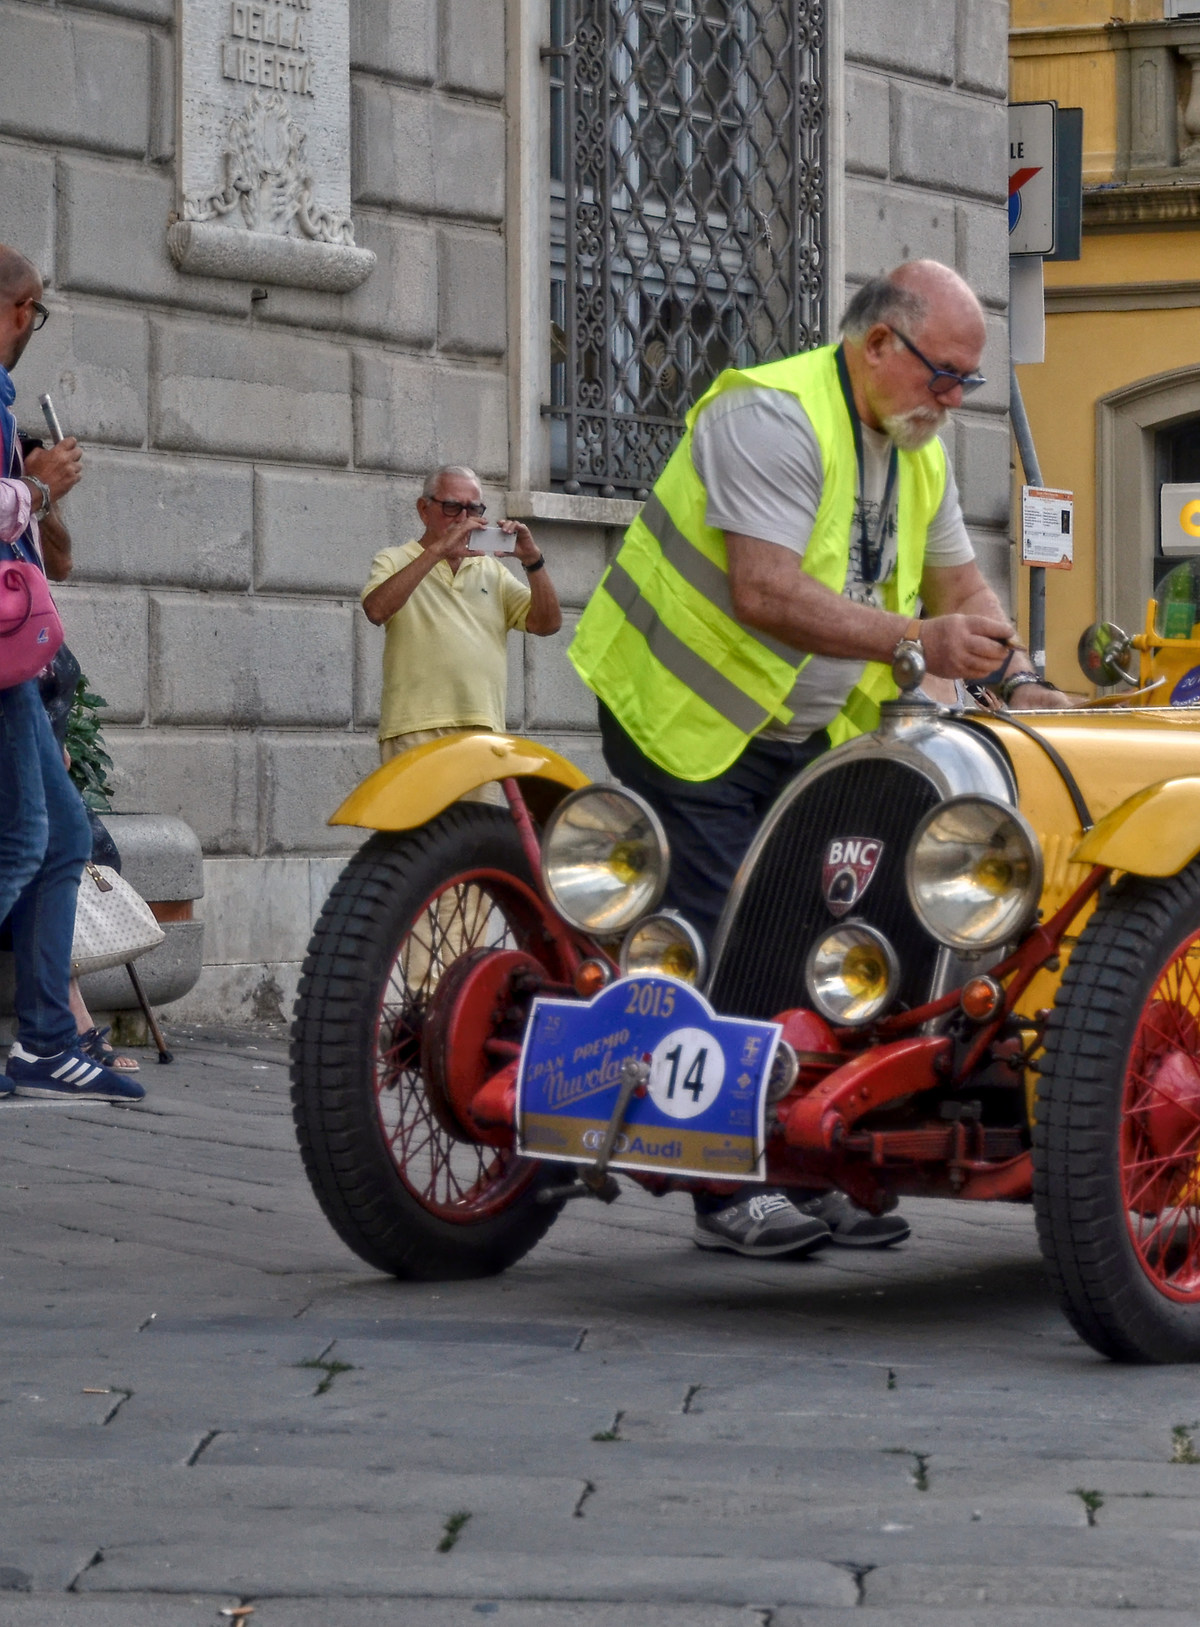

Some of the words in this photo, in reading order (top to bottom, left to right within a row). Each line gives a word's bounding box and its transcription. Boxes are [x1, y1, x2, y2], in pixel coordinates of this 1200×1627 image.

[230, 2, 306, 53] DELLA
[828, 841, 878, 866] BNC
[625, 983, 676, 1018] 2015
[573, 1028, 630, 1064] PREMIO
[665, 1044, 708, 1103] 14
[630, 1137, 682, 1158] Audi
